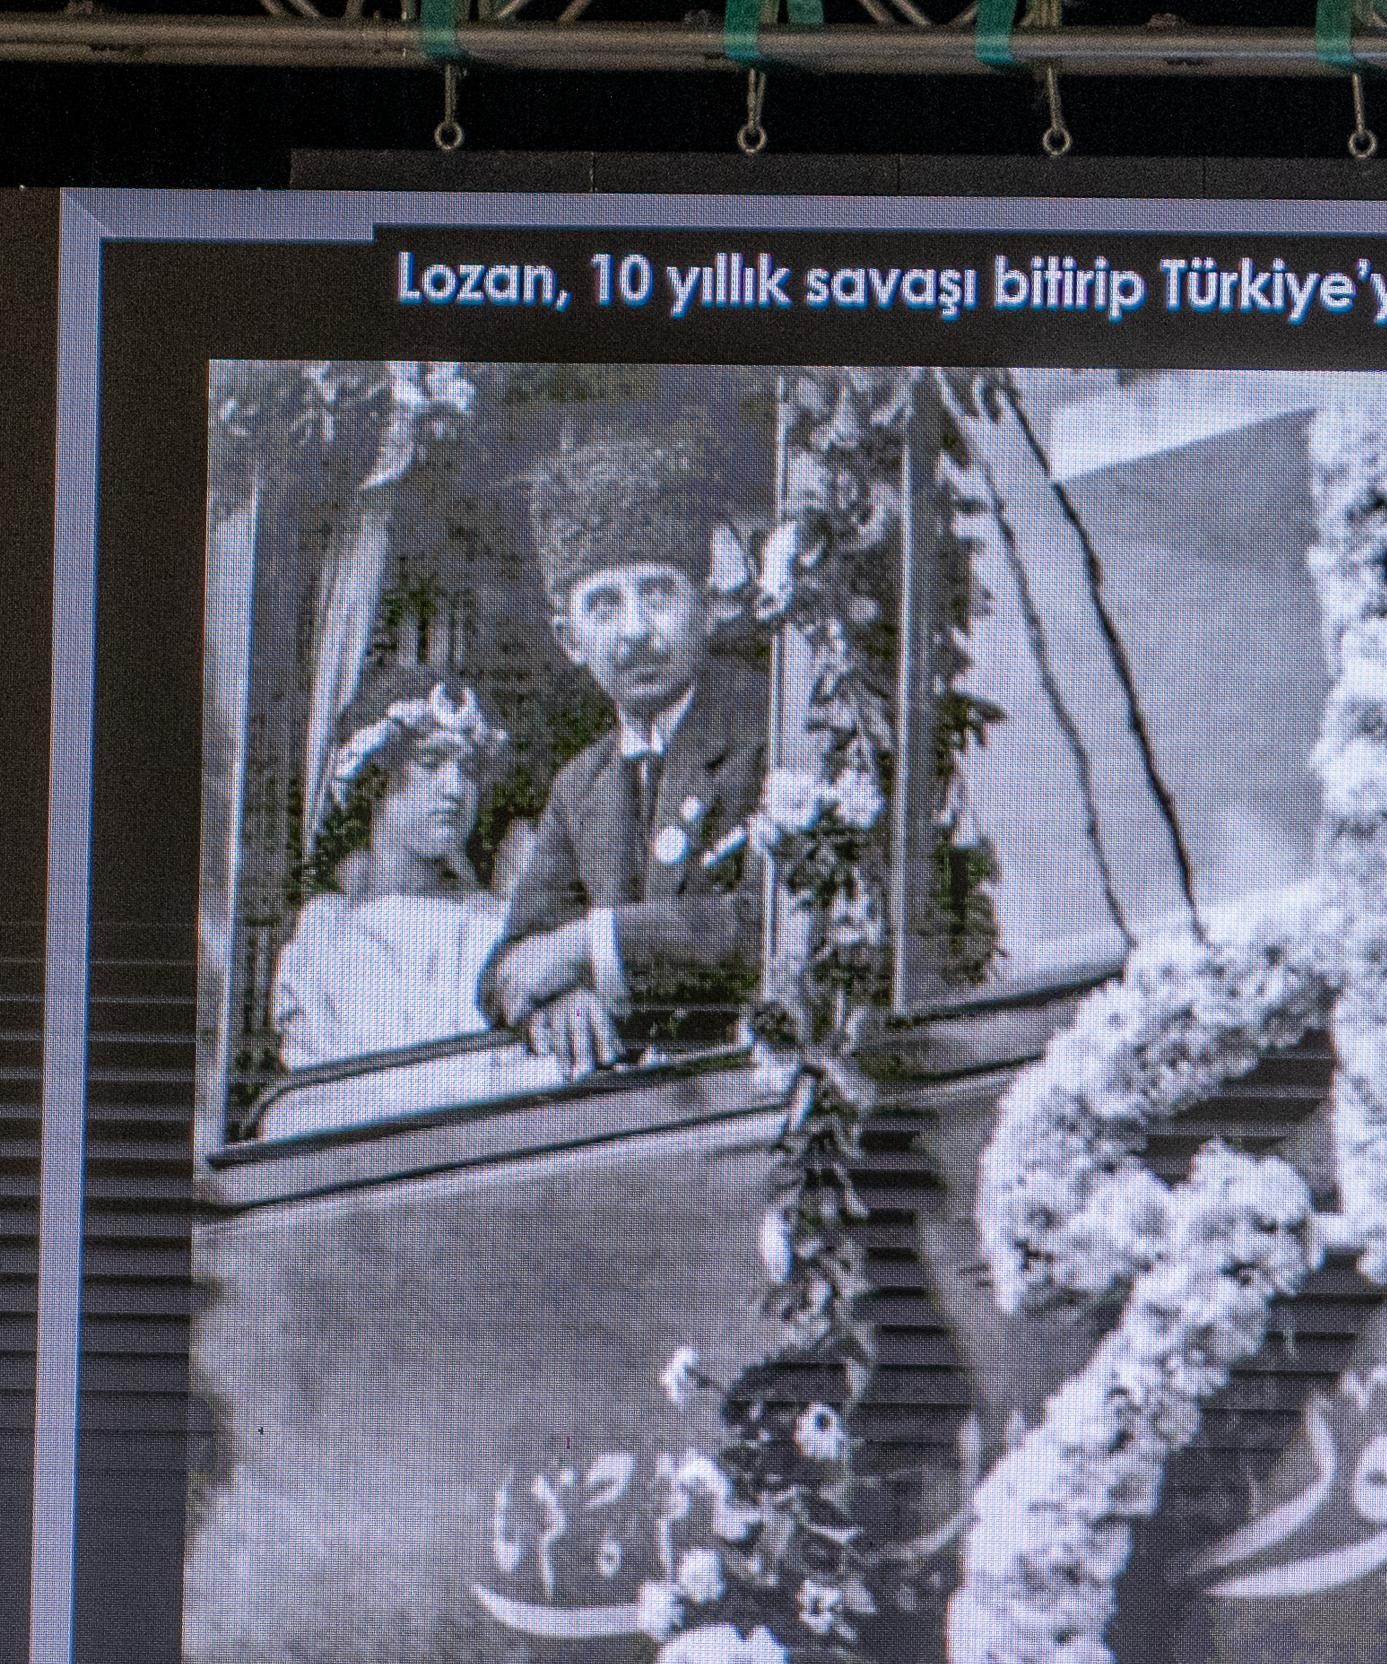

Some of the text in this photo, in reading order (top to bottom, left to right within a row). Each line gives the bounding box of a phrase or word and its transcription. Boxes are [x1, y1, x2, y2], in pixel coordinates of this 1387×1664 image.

[396, 250, 571, 311] Lozan,
[591, 252, 654, 307] 10
[665, 252, 792, 319] yıllık
[805, 267, 978, 322] savaşı
[993, 254, 1147, 323] bitirip
